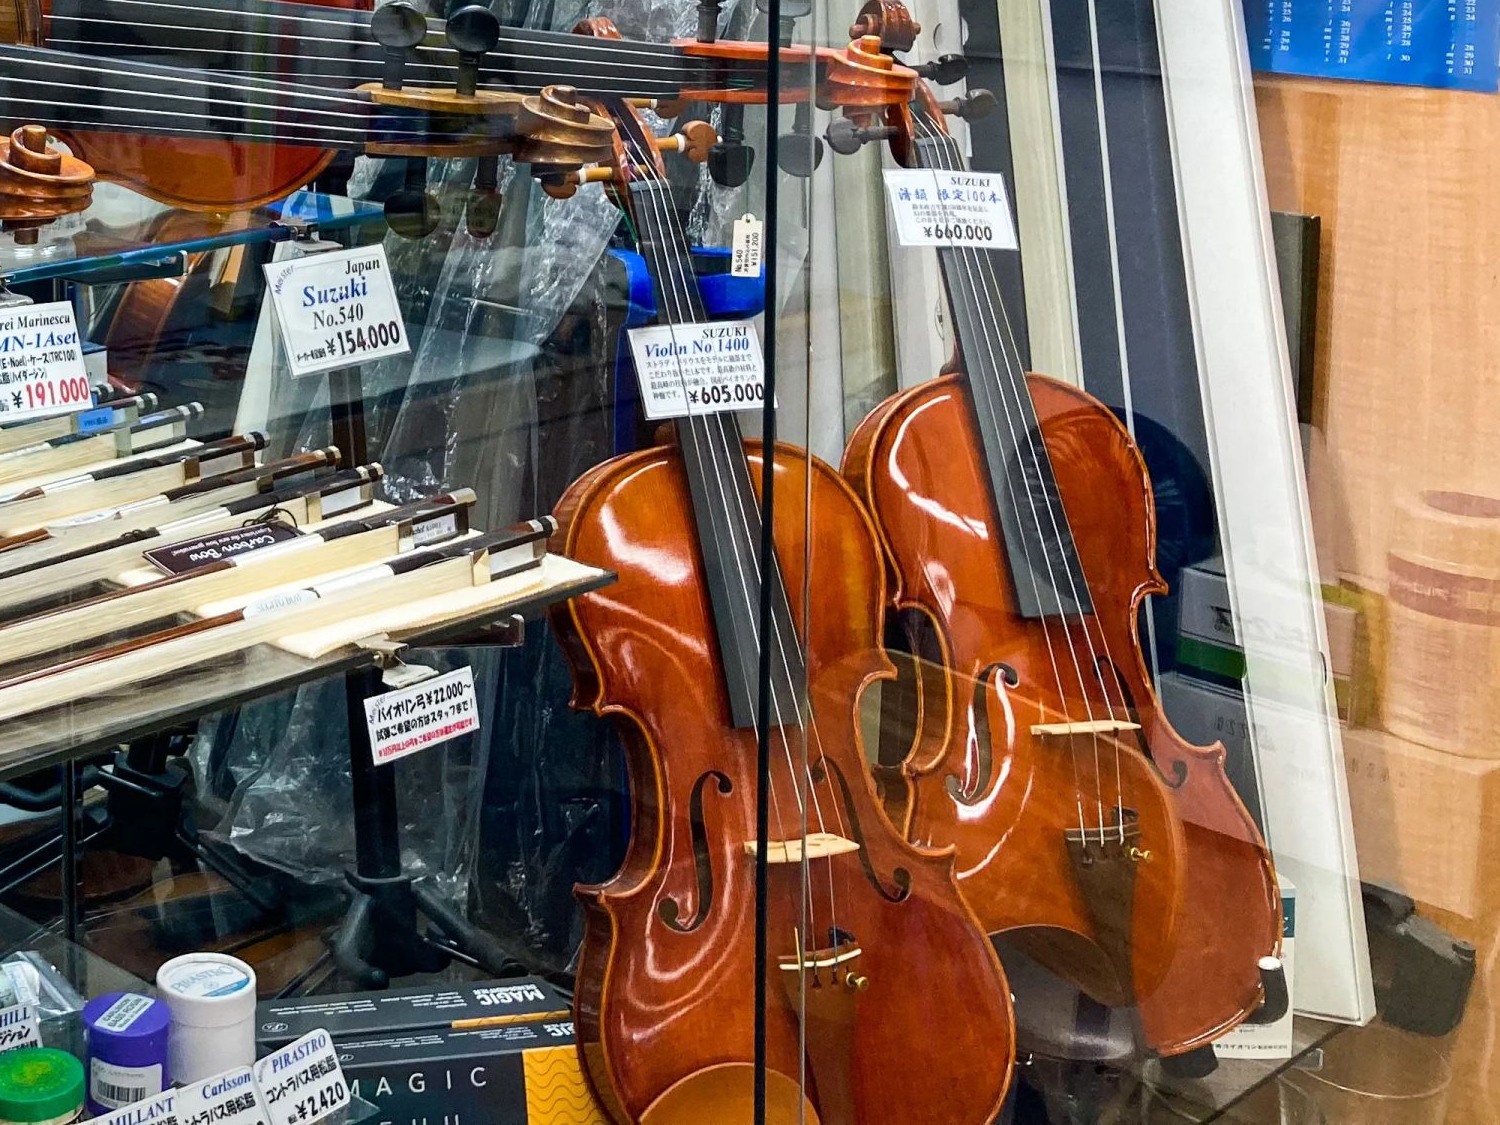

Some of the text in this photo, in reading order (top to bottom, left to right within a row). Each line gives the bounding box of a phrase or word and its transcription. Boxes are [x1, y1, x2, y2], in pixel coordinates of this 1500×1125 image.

[951, 176, 990, 187] SUZUKI
[345, 258, 380, 275] Japan
[303, 276, 368, 307] Suzuki
[17, 313, 70, 330] Marinescu
[313, 303, 363, 330] No.540
[702, 327, 747, 339] SUZUKI
[644, 342, 687, 358] Violin
[718, 338, 749, 352] 1400
[190, 533, 275, 563] Carbon Bow
[0, 1007, 31, 1028] HILL
[272, 1034, 327, 1074] PIRASTRO
[202, 1073, 251, 1100] Carlsson
